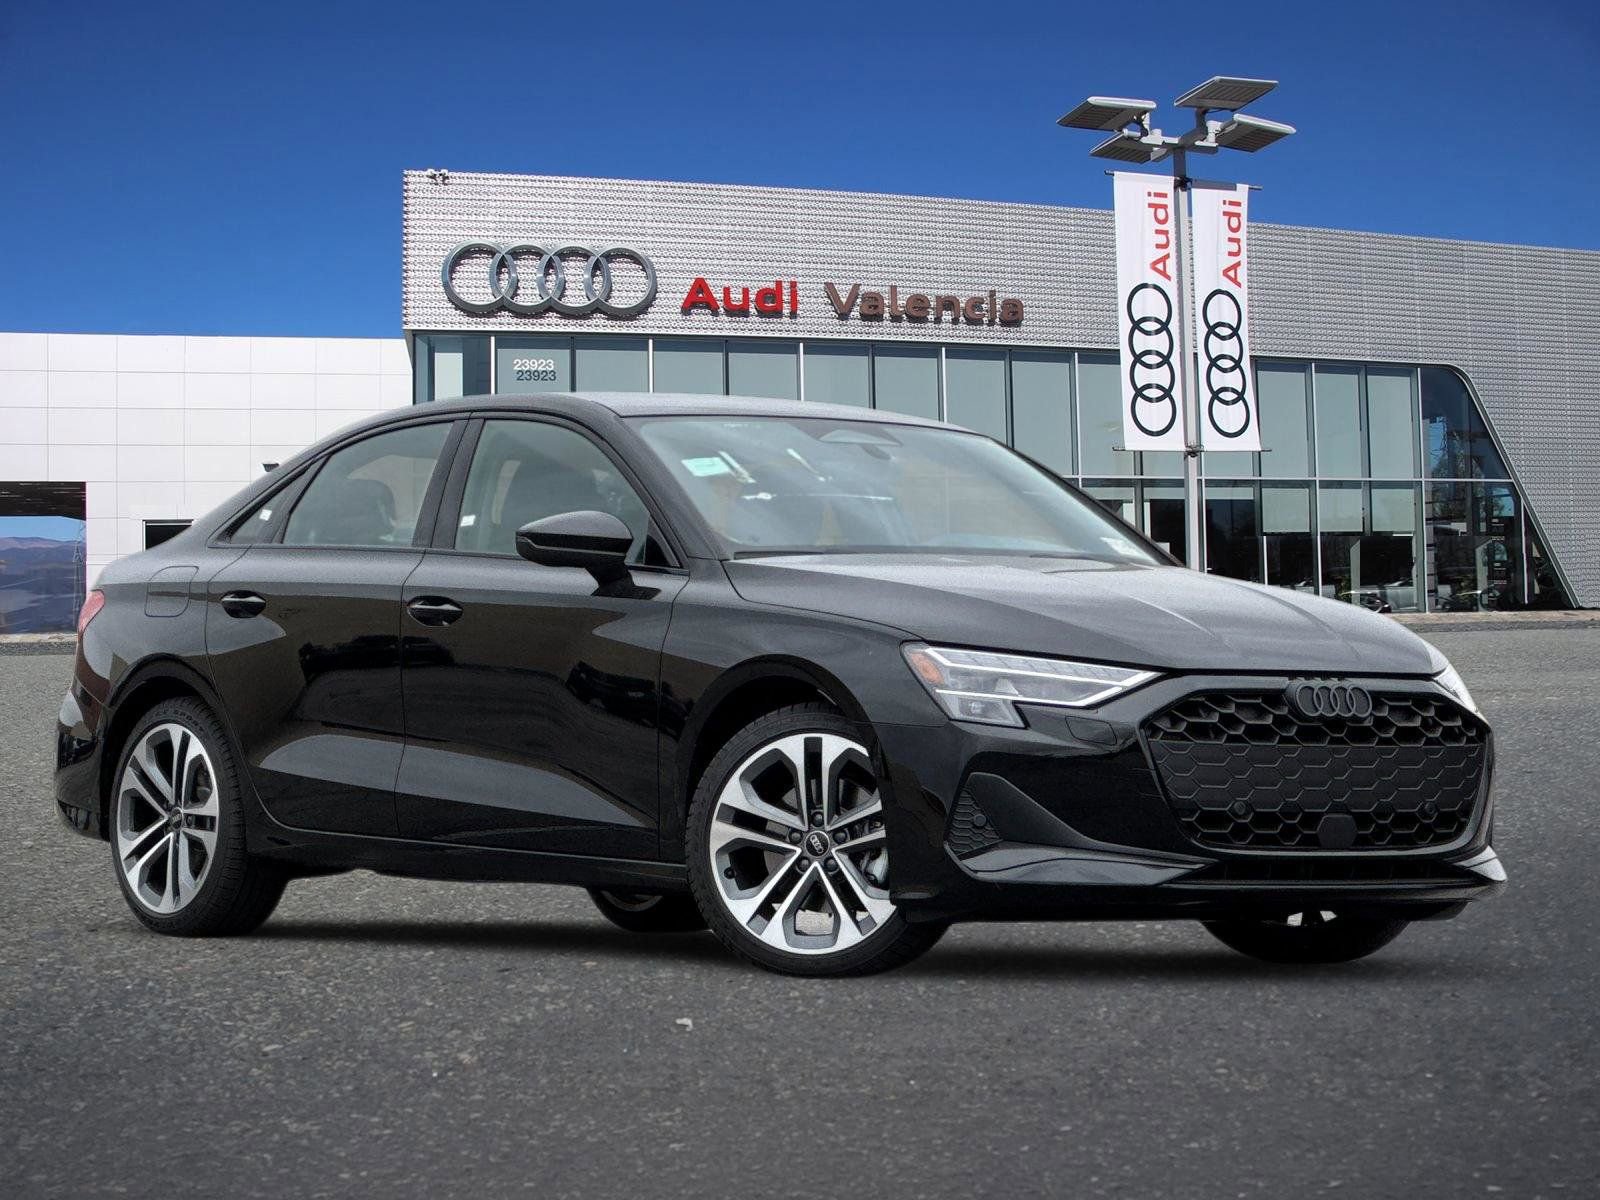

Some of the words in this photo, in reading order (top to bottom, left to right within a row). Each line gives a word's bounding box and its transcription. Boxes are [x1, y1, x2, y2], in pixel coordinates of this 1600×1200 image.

[1147, 191, 1172, 281] Audi
[1222, 199, 1242, 288] Audi
[680, 277, 798, 317] Audi
[823, 281, 1024, 325] Valencia
[513, 359, 554, 371] 23923
[516, 370, 557, 381] 23923
